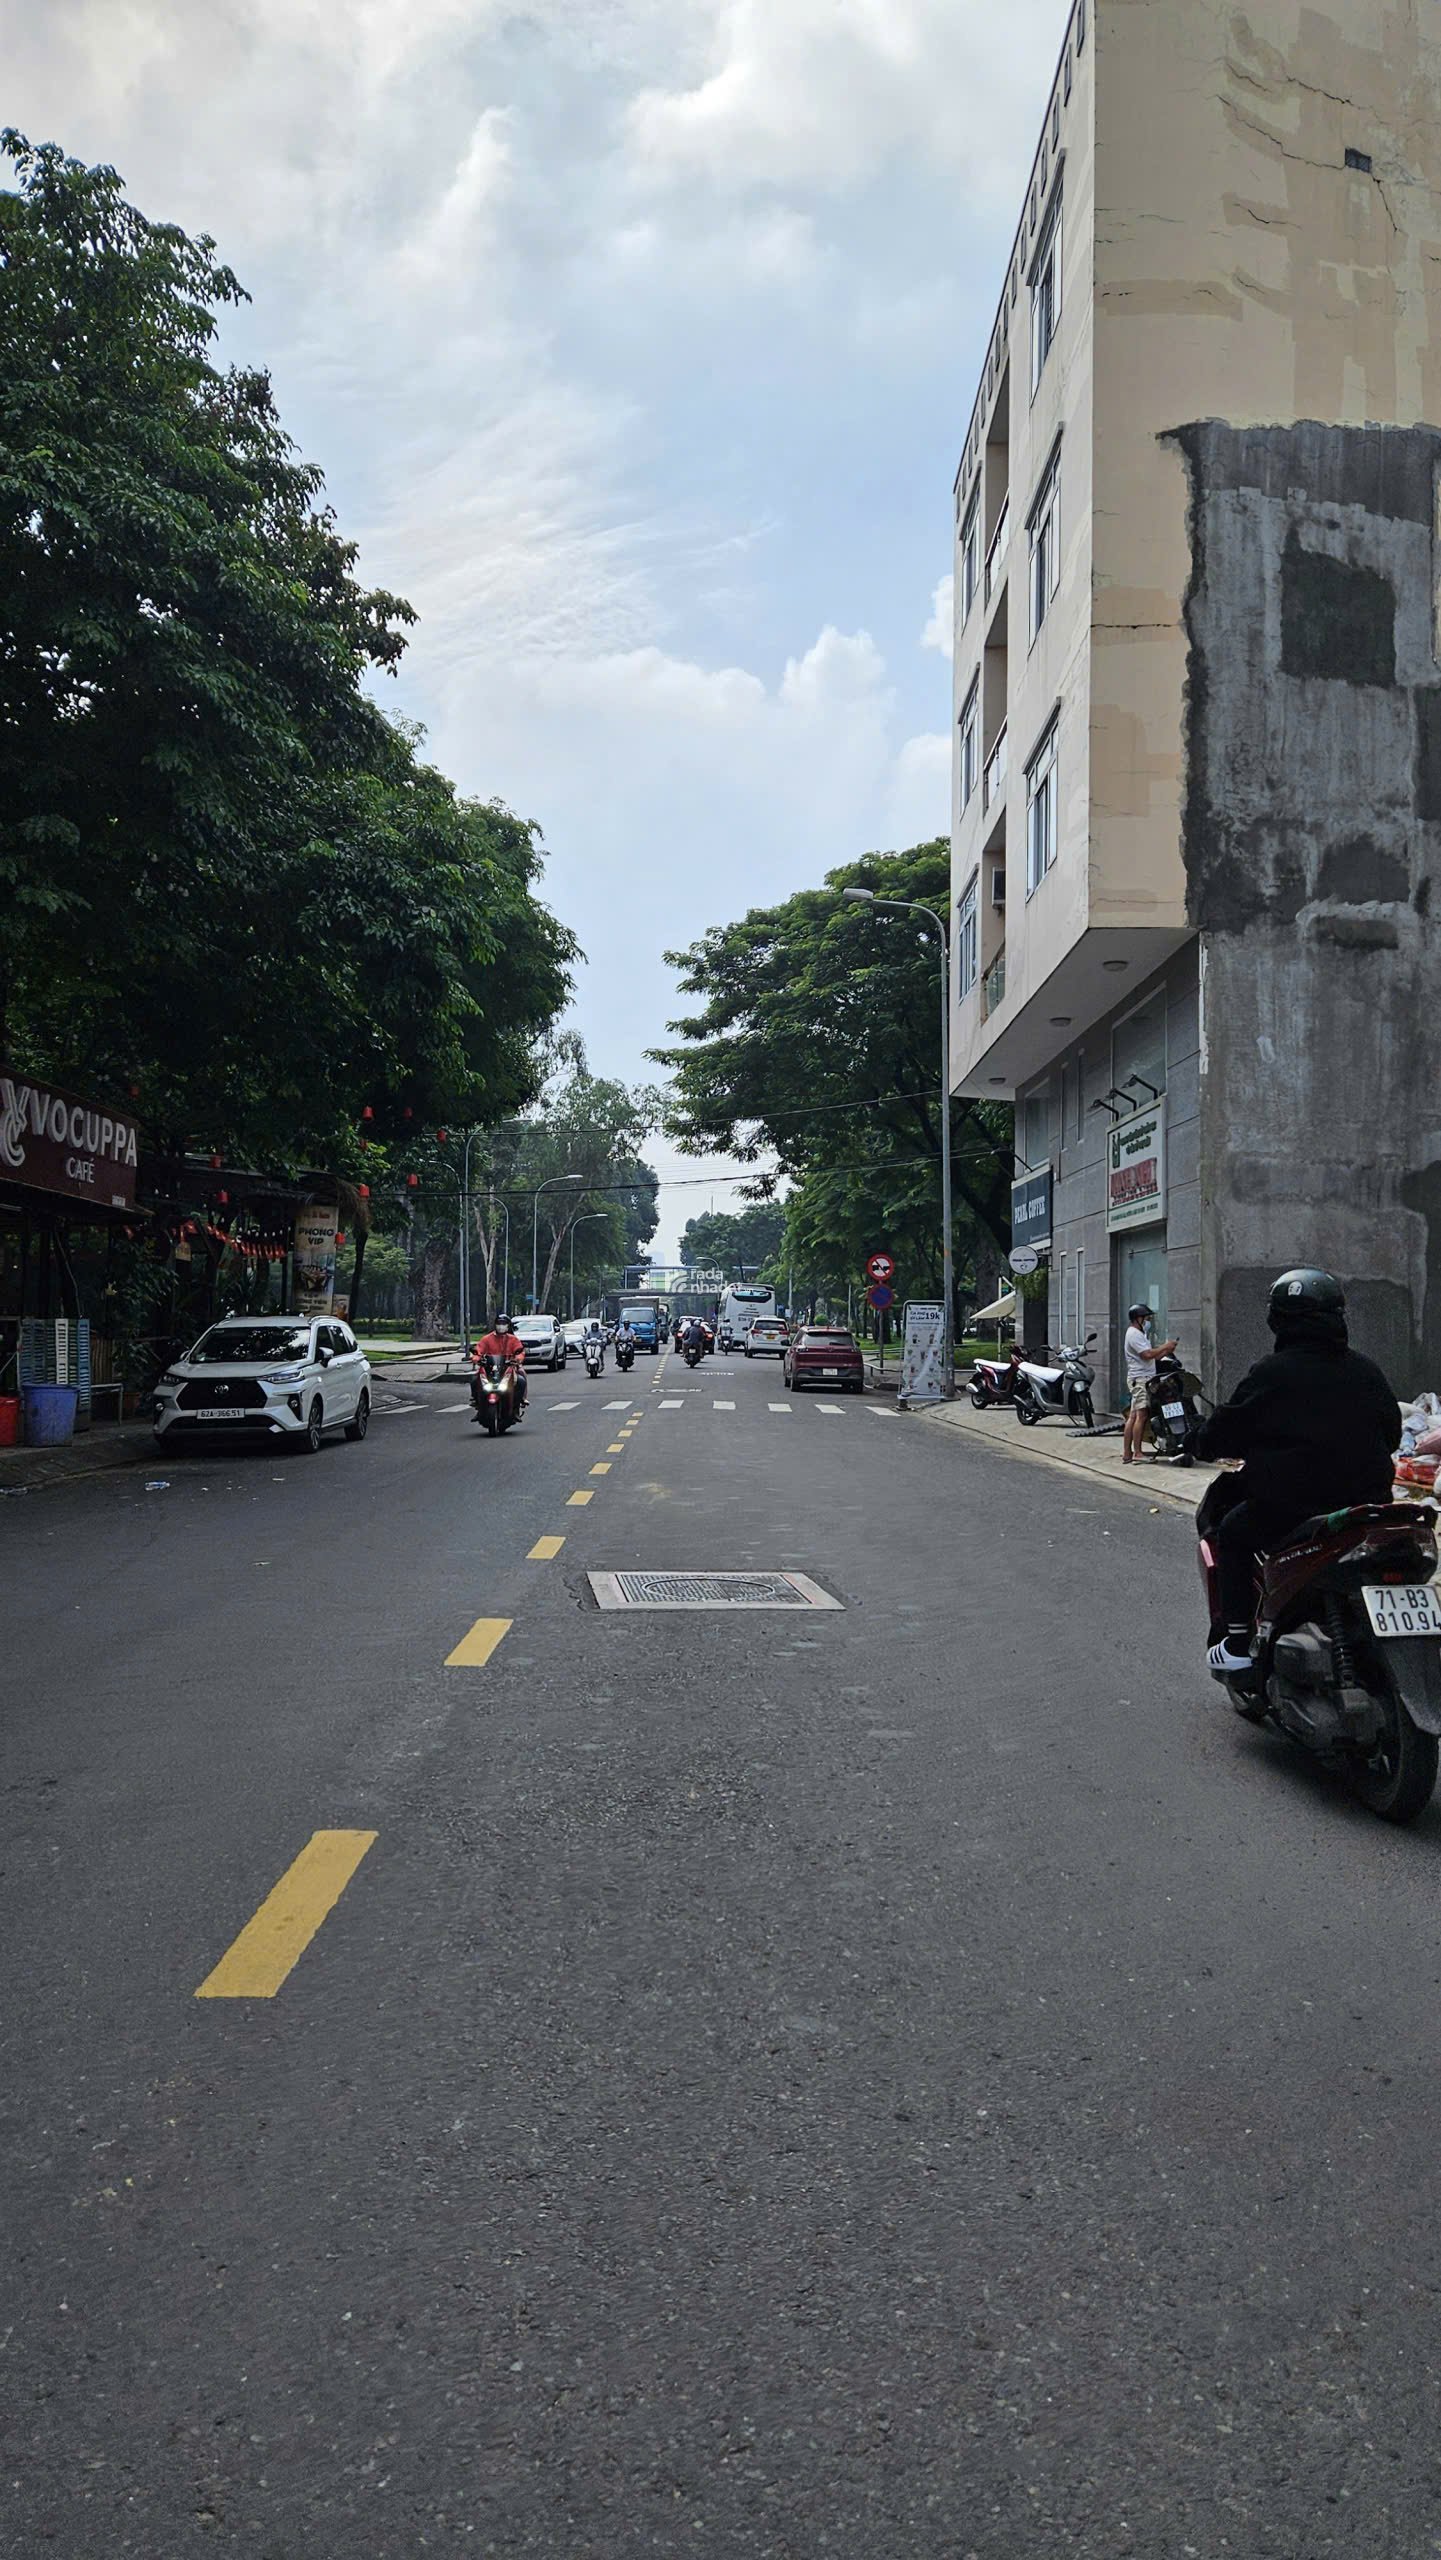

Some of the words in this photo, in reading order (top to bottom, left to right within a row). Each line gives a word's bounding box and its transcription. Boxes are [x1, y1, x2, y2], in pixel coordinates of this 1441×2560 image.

[30, 1089, 138, 1168] VOCUPPA
[925, 1311, 941, 1321] 19k
[1375, 1588, 1429, 1610] 71-B3
